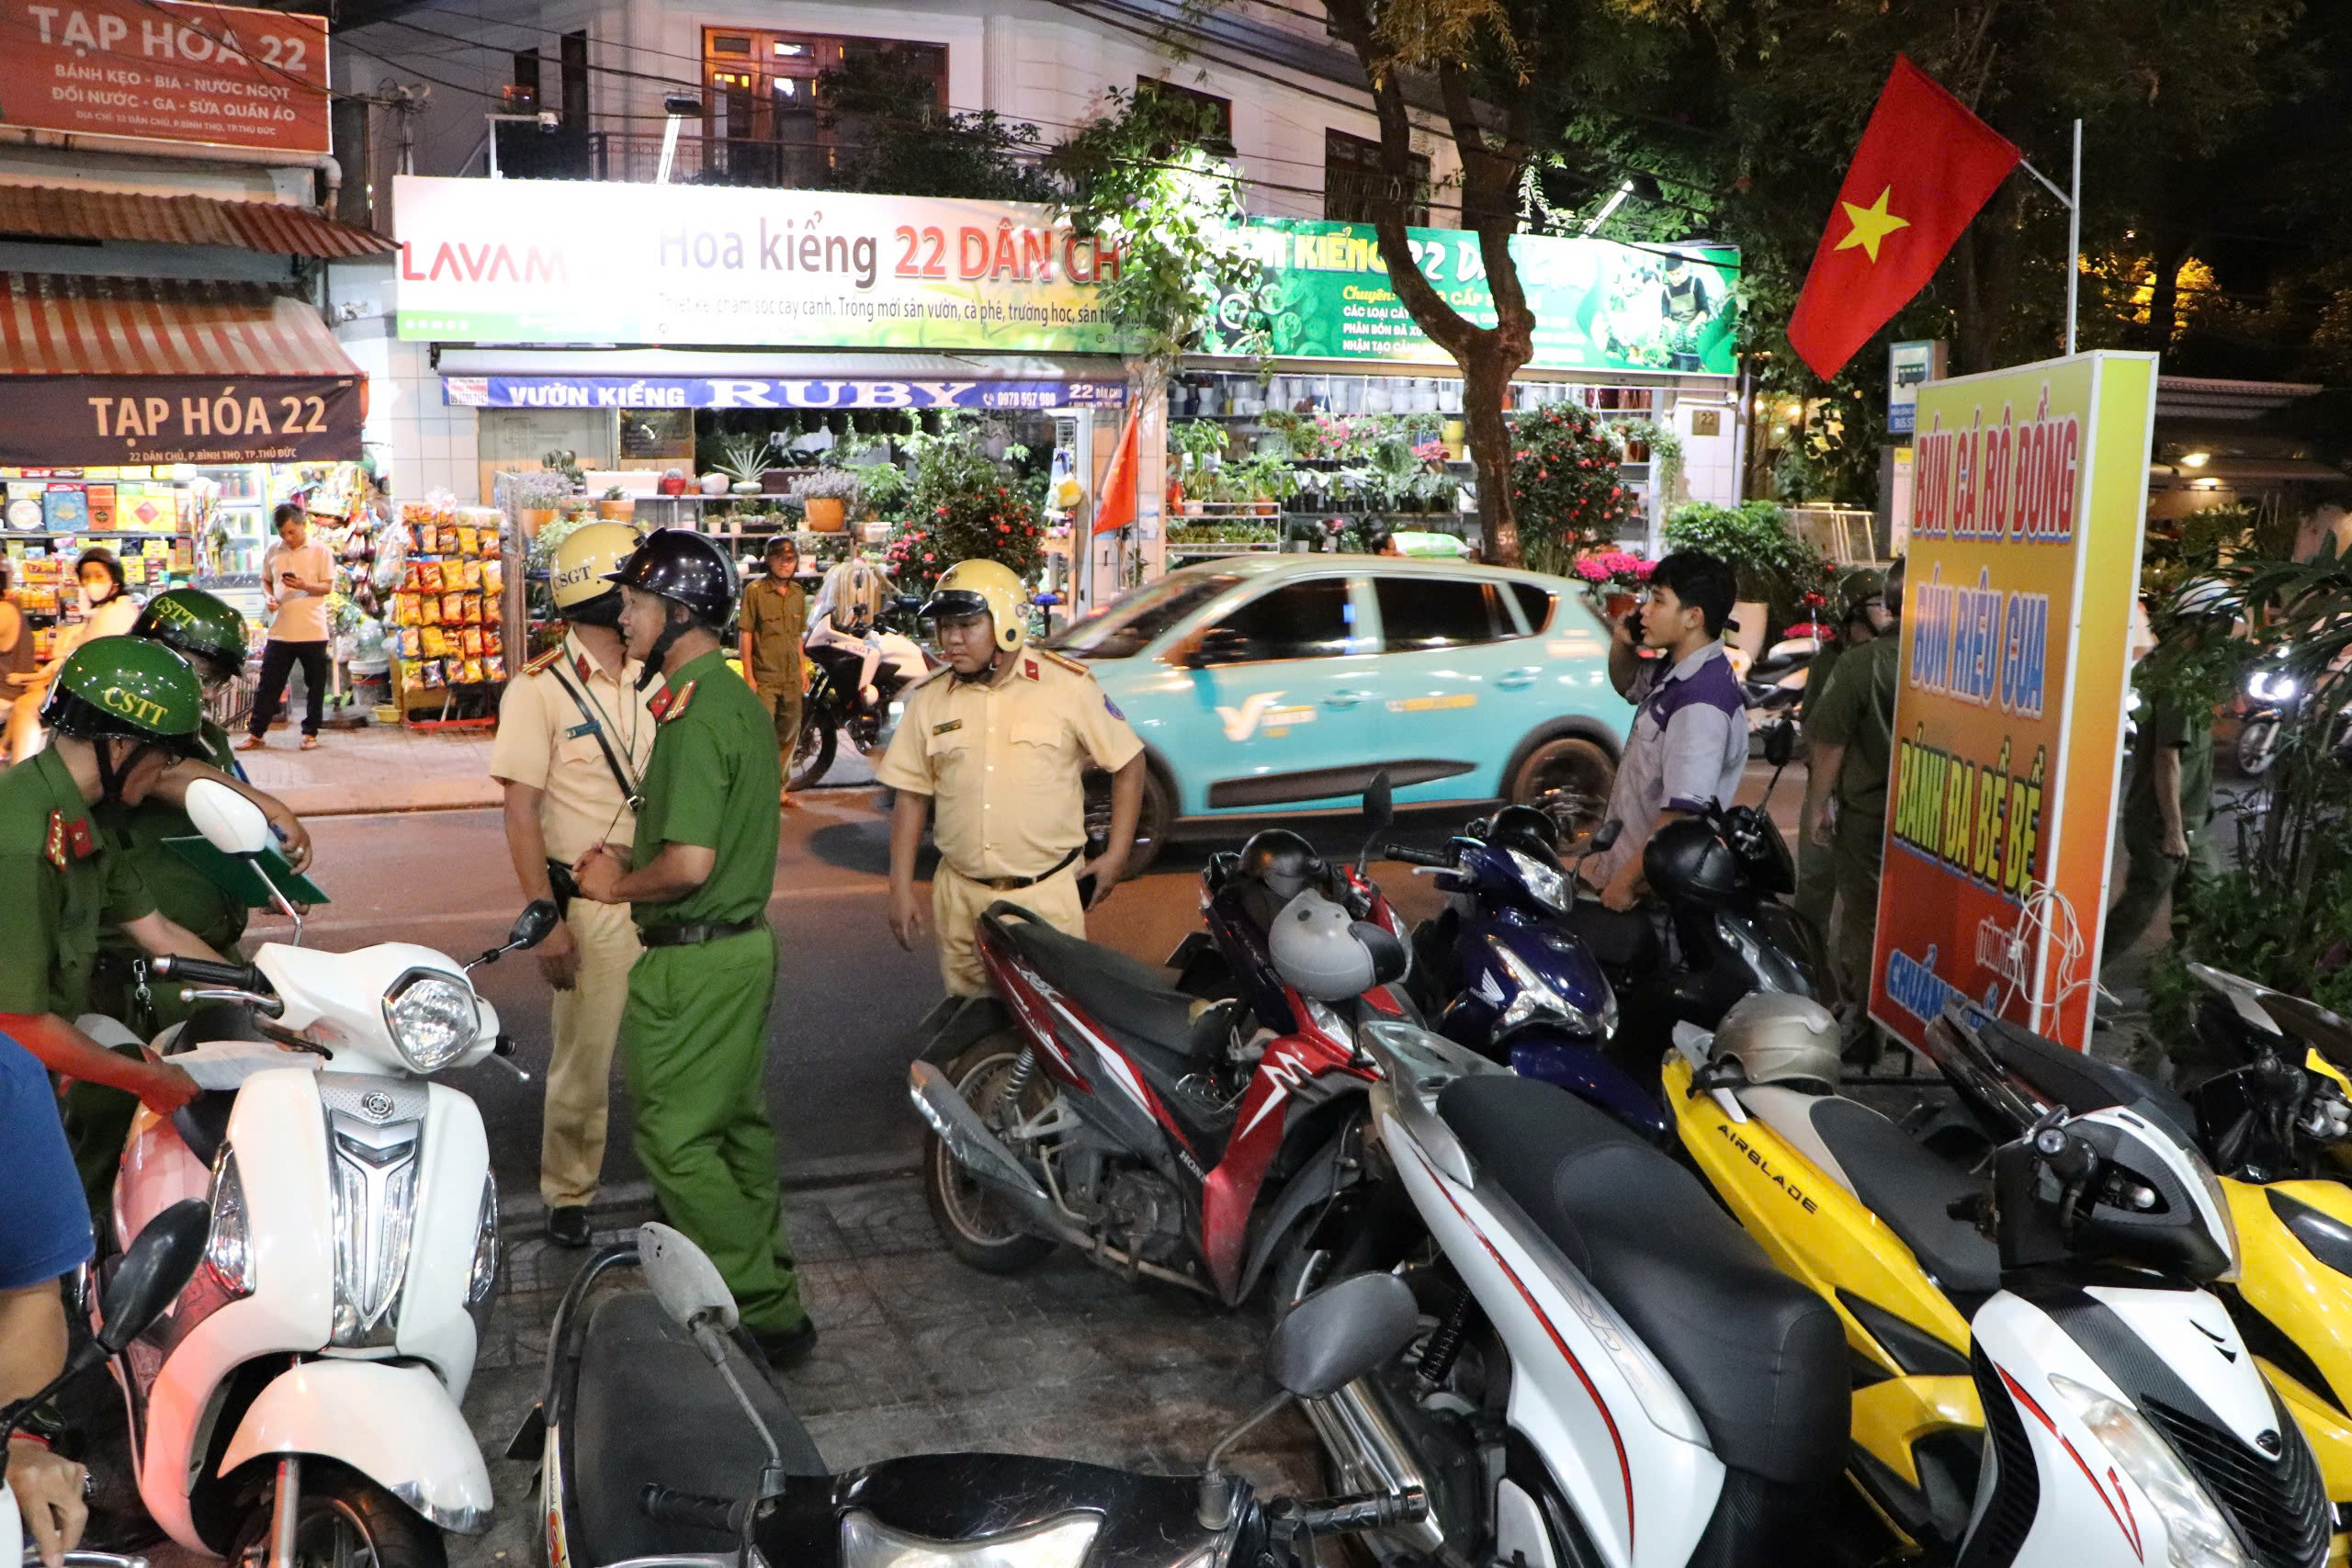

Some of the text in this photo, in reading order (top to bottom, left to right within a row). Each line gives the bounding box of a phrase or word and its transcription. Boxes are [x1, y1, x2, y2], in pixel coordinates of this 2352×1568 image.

[28, 5, 307, 71] TẠP HÓA 22
[55, 63, 289, 101] BÁNH KẸO BIA NƯỚC NGỌT
[87, 88, 140, 107] NƯỚC
[153, 97, 175, 111] GA
[272, 104, 296, 121] ÁO
[659, 209, 1123, 289] Hoa kiểng 22 DÂN CH
[877, 297, 900, 318] mới
[904, 297, 924, 318] sân
[927, 299, 962, 321] vườn,
[965, 299, 977, 321] cà
[980, 299, 1005, 324] phê,
[1008, 301, 1048, 327] trường
[1051, 301, 1075, 327] học,
[1078, 303, 1097, 323] sân
[1342, 285, 1396, 304] Chuyên:
[1342, 304, 1366, 319] CÁC
[1367, 307, 1388, 321] LOẠI
[1342, 321, 1370, 334] PHÂN
[1372, 321, 1392, 336] BÓN
[1342, 337, 1371, 353] NHẬN
[1372, 341, 1391, 355] TẠO
[508, 382, 590, 407] VƯỜN
[706, 379, 977, 409] RUBY
[997, 391, 1020, 407] 0978
[1021, 391, 1037, 407] 597
[1069, 384, 1093, 399] 22
[88, 386, 328, 446] TẠP HÓA 22
[130, 452, 141, 462] 22
[143, 450, 164, 461] DÂN
[189, 448, 220, 461] P.BÌNH
[221, 450, 243, 462] THỌ,
[245, 446, 277, 459] TP.THỦ
[277, 446, 297, 458] ĐỨC
[1912, 412, 1951, 540] BÚN
[1952, 404, 1981, 540] CÁ
[1980, 401, 2013, 542] RÔ
[154, 596, 198, 629] CSTT
[1910, 561, 2048, 719] BÚN RIÊU CUA
[104, 686, 169, 726] CSTT
[1894, 721, 1949, 862] BÁNH
[1941, 754, 1974, 875] ĐA
[1717, 1123, 1819, 1215] AIRBLADE
